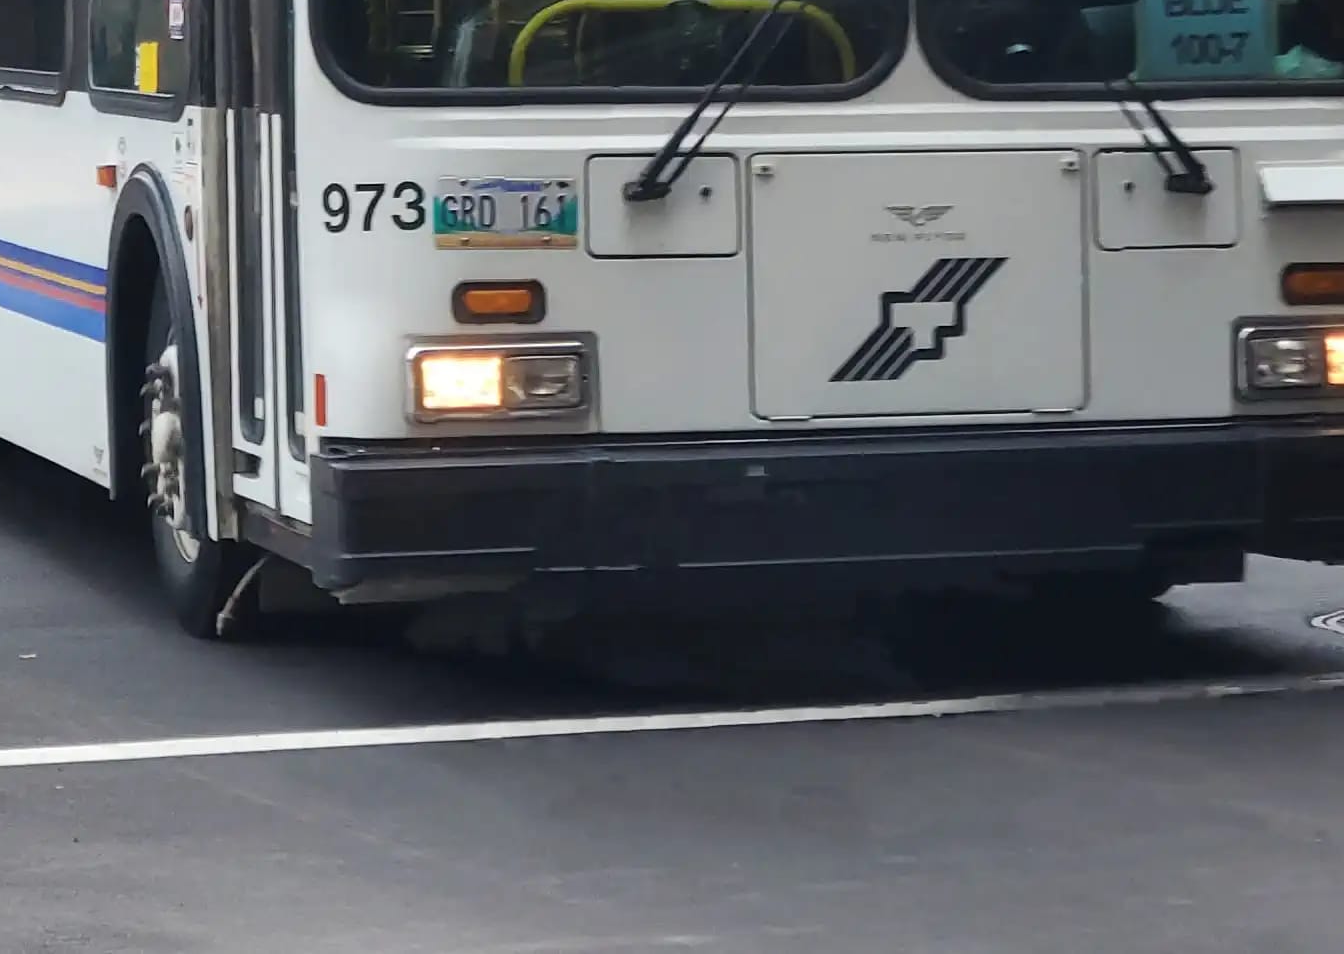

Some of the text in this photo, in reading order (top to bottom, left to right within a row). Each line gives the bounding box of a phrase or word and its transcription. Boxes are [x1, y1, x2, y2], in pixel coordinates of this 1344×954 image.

[322, 180, 427, 234] 973
[441, 193, 569, 231] GRD 161
